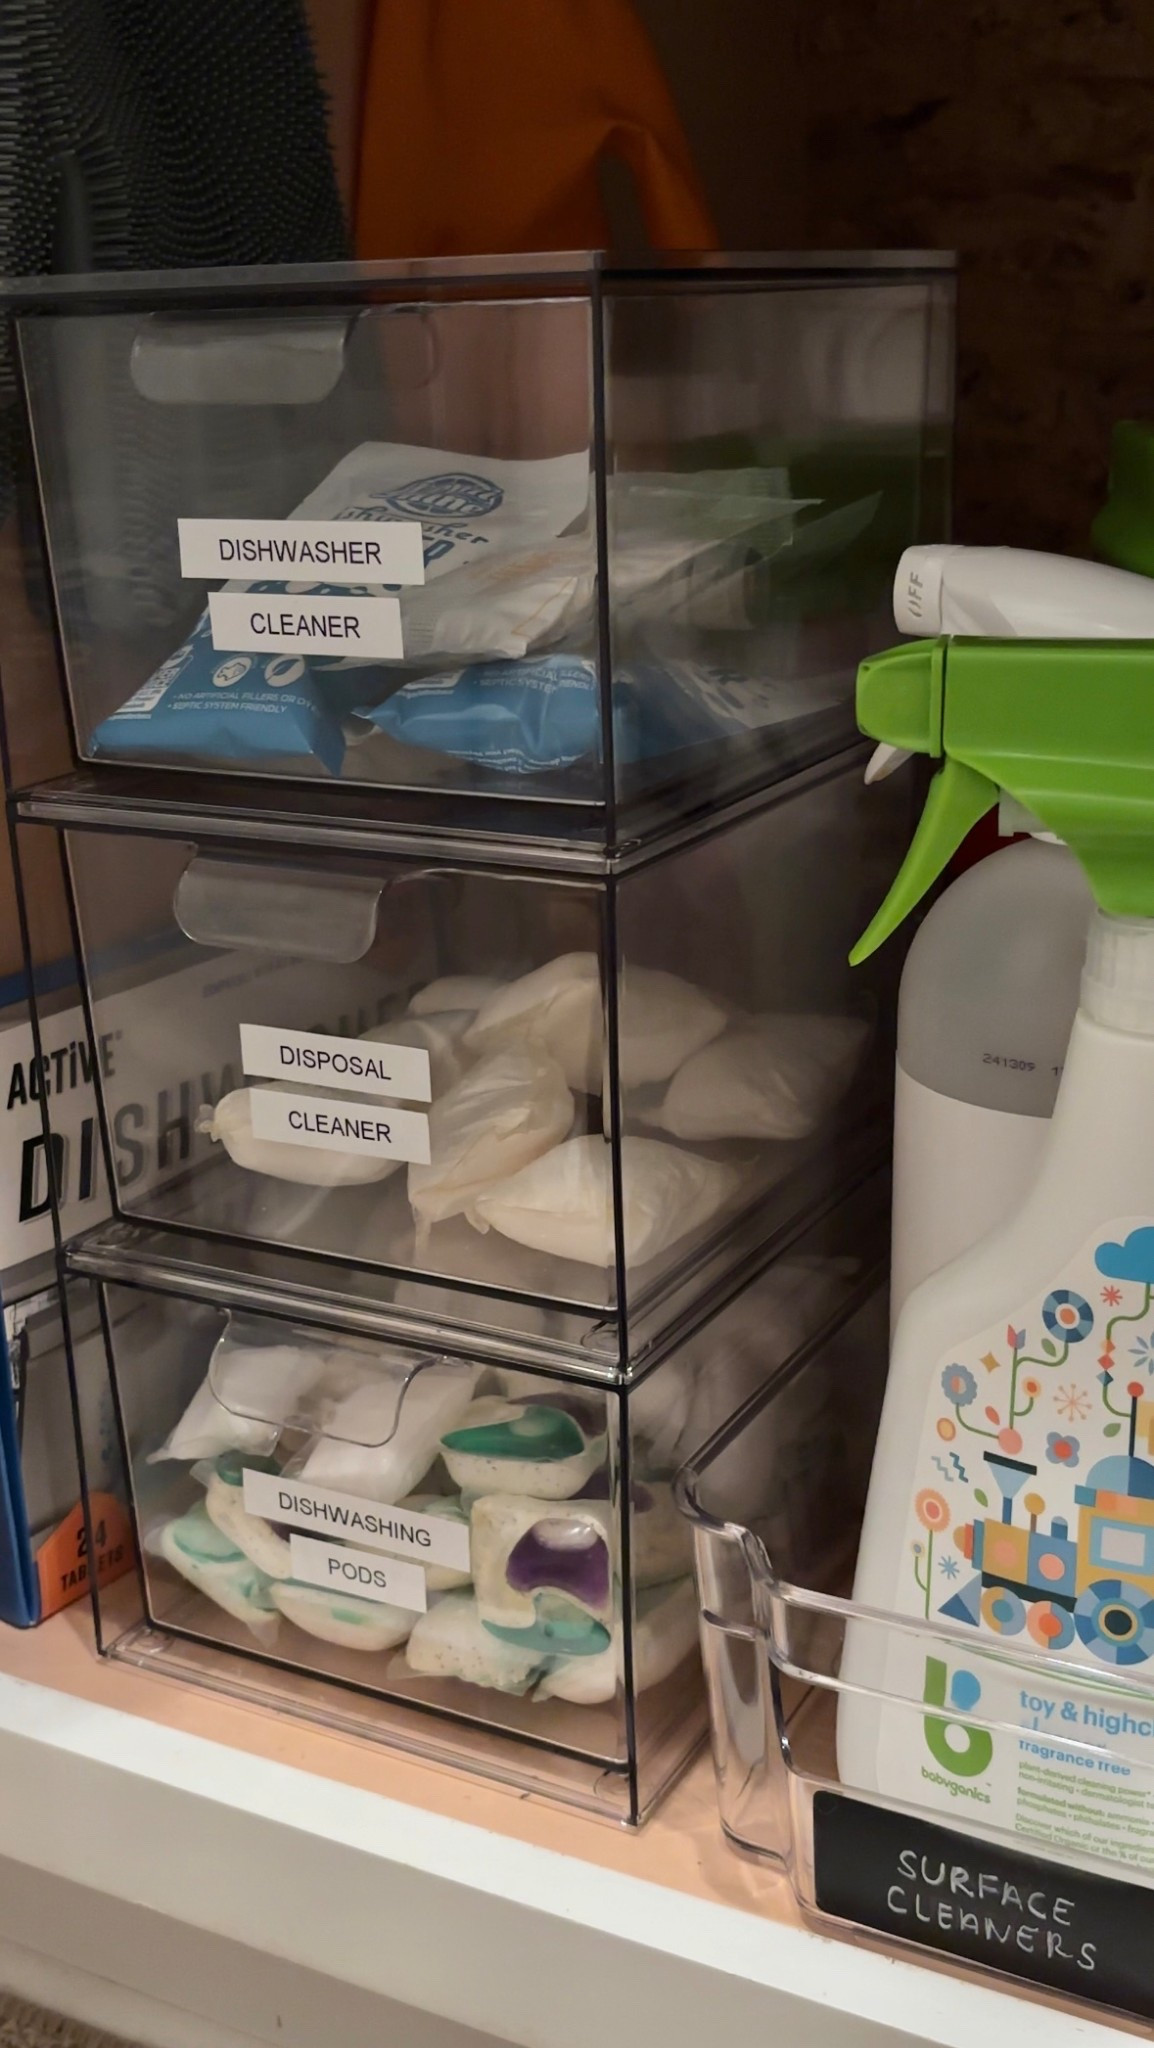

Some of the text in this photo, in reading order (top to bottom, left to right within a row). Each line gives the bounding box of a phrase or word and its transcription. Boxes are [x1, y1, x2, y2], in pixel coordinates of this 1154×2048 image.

[219, 538, 382, 565] DISHWASHER
[908, 571, 923, 618] OFF
[250, 612, 361, 639] CLEANER
[172, 701, 288, 714] SEPTIC SYSTEM FRIENDLY
[194, 692, 239, 700] ARTIFICIAL
[241, 692, 279, 702] FILLERS
[280, 694, 295, 703] OR
[280, 1045, 392, 1080] DISPOSAL
[288, 1110, 392, 1144] CLEANER
[278, 1491, 432, 1547] DISHWASHING
[61, 1544, 124, 1592] TABETS
[328, 1557, 387, 1588] PODS
[1019, 1690, 1154, 1737] toy & highc
[1019, 1739, 1131, 1776] fragrance free
[1015, 1812, 1052, 1830] Discover
[1053, 1825, 1081, 1839] which
[897, 1850, 1075, 1926] SURFACE
[887, 1885, 1097, 1970] CLEANERS
